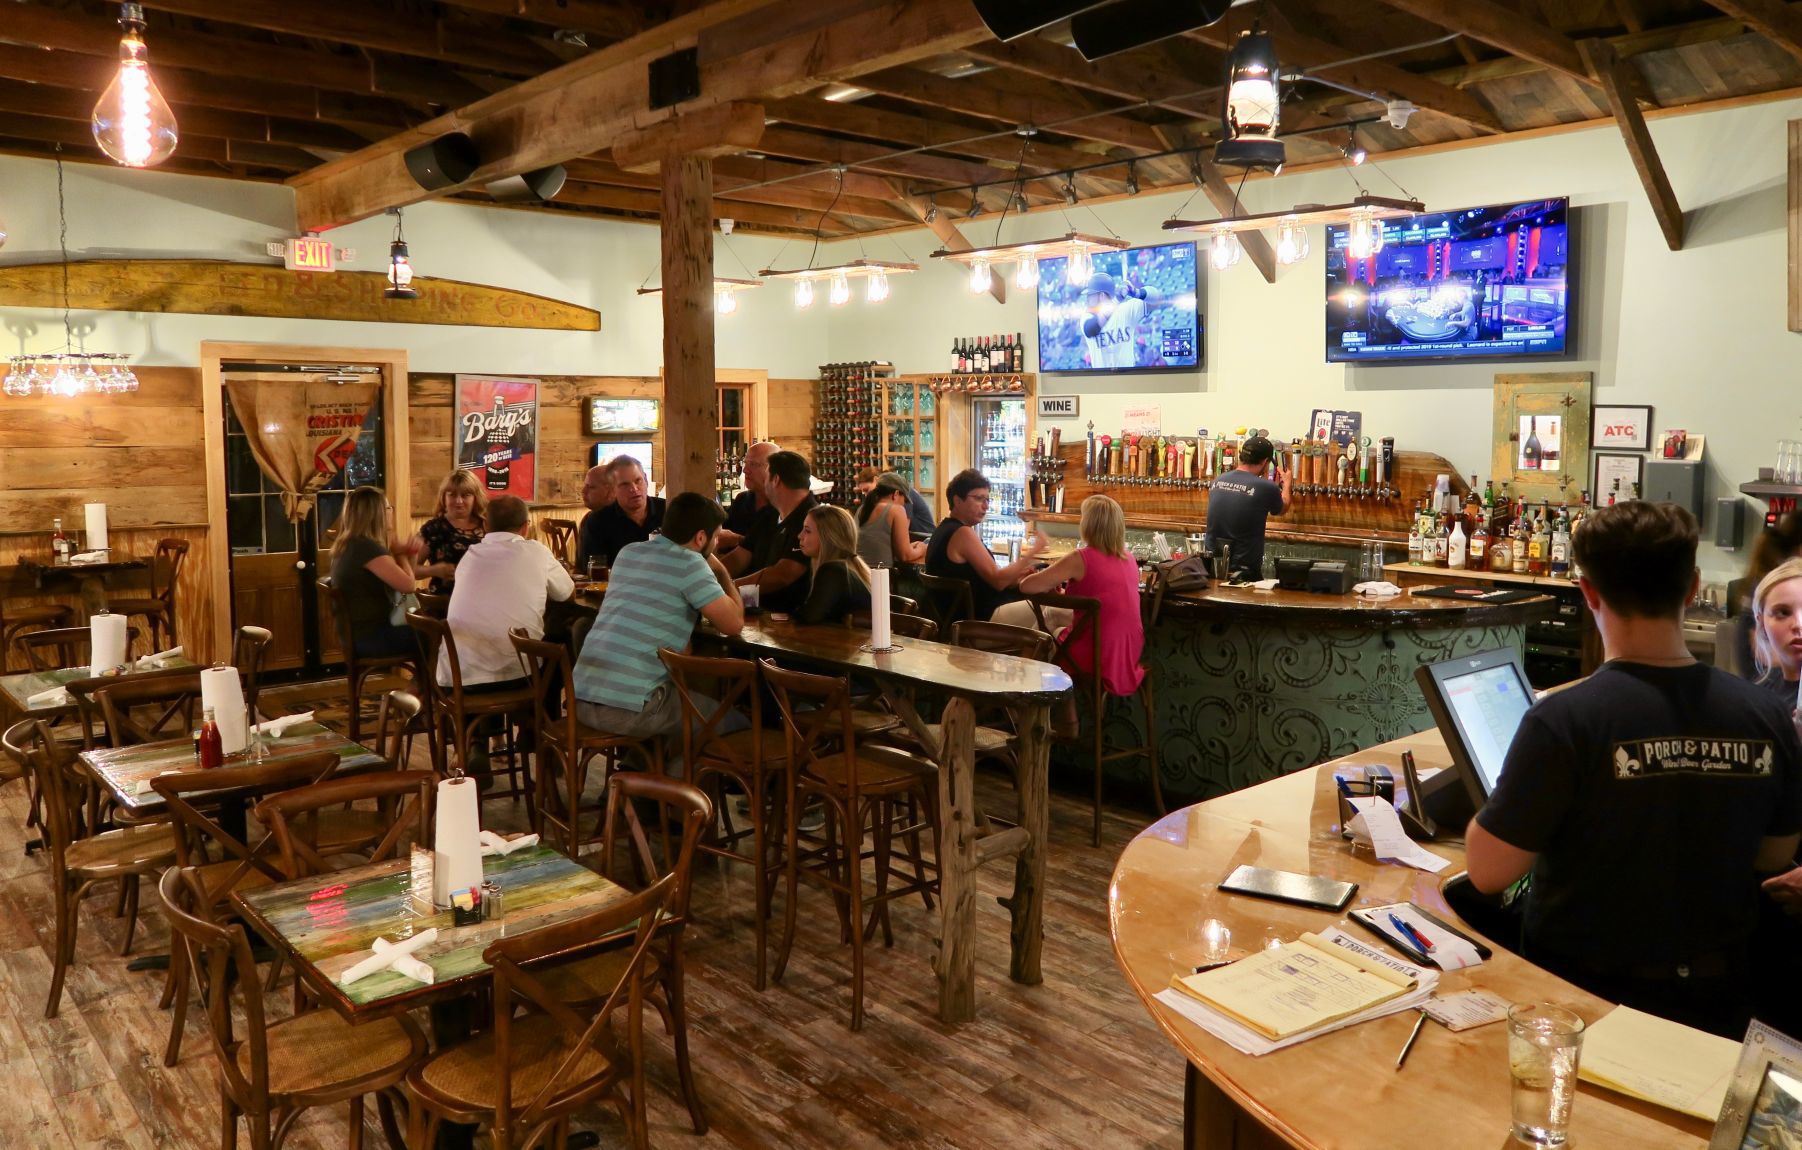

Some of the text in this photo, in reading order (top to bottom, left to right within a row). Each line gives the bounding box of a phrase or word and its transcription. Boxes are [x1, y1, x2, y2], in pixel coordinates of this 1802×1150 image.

[295, 240, 329, 268] EXIT
[1095, 326, 1131, 348] TEXAS
[1043, 400, 1072, 411] WINE
[462, 408, 532, 442] Barq's
[1604, 425, 1634, 436] ATC
[483, 452, 498, 464] 120
[1644, 740, 1749, 764] PORCH & PATIO
[1701, 759, 1731, 771] Garden
[1345, 943, 1373, 957] PORCH
